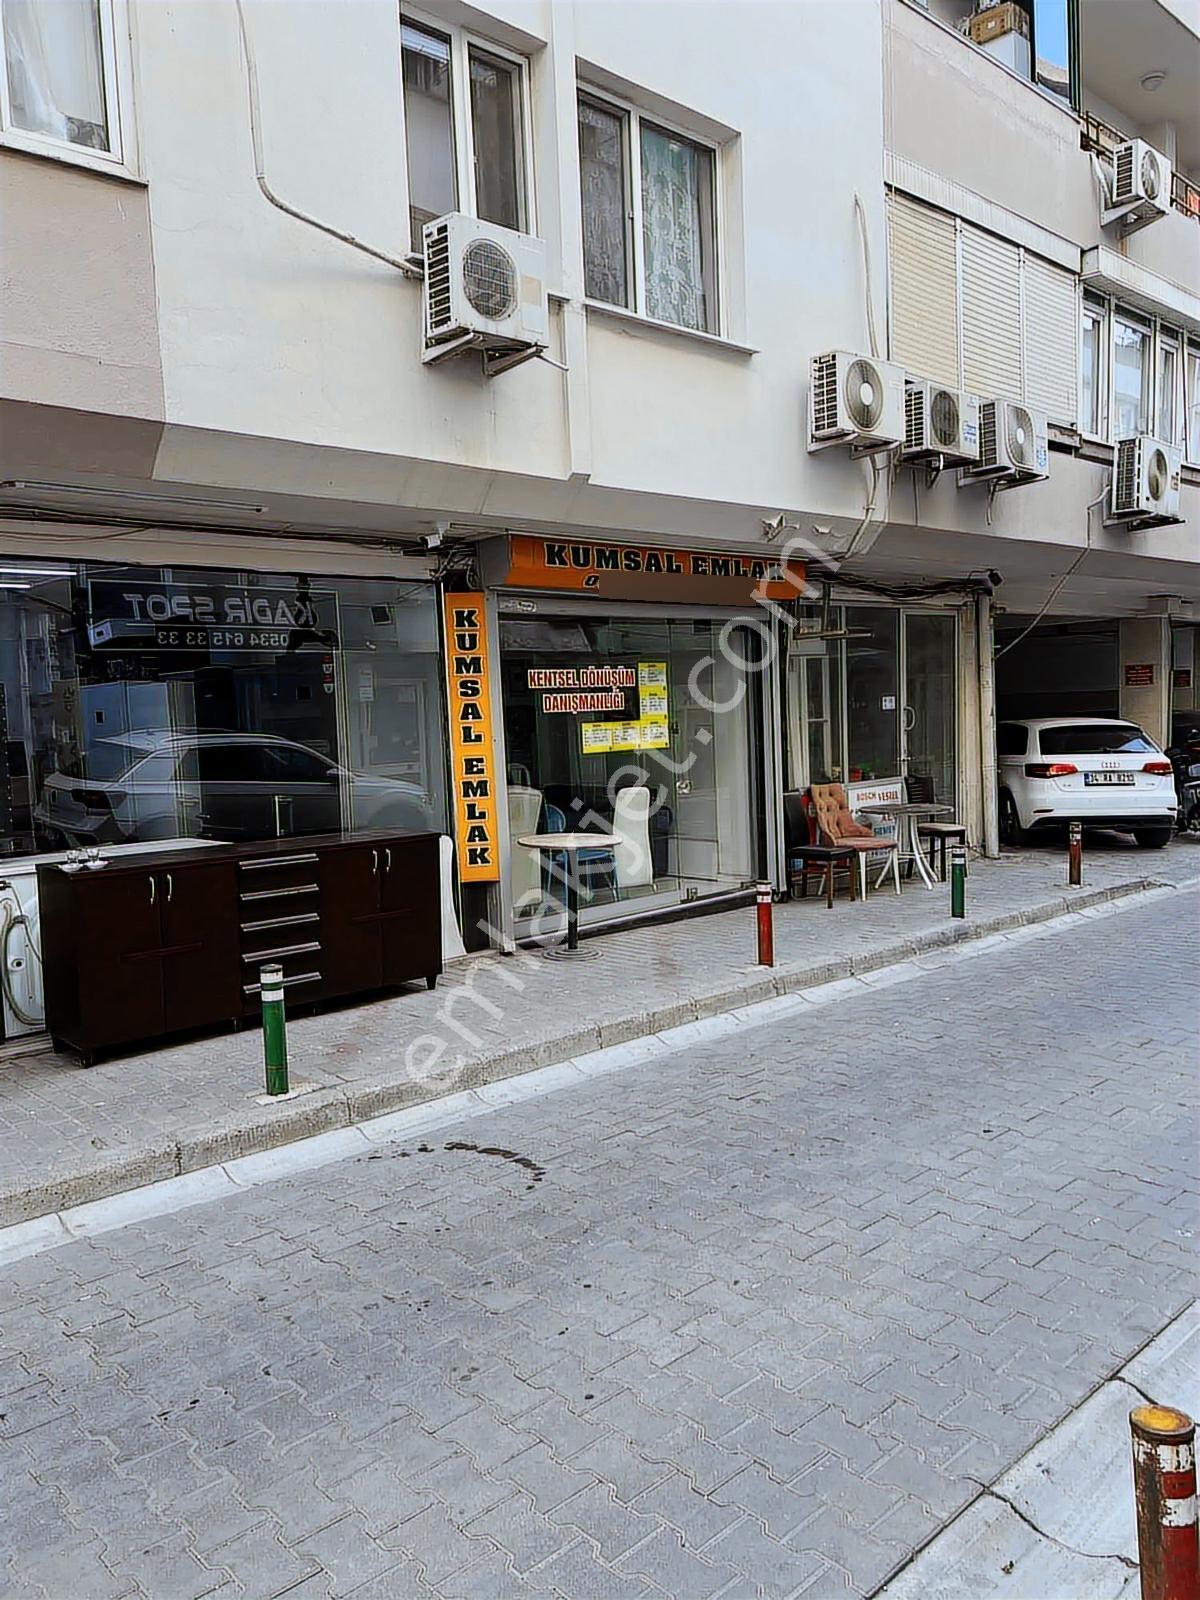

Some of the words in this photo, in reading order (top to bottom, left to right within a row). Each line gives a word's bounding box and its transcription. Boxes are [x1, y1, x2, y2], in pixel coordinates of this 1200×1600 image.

[544, 542, 683, 574] KUMSAL
[690, 555, 786, 582] EMLAK
[453, 608, 484, 744] KUMSAL
[528, 669, 579, 688] KENTSEL
[580, 666, 636, 689] DÖNÜŞÜM
[543, 688, 624, 714] DANIŞMANLIĞI
[461, 757, 491, 866] EMLAK
